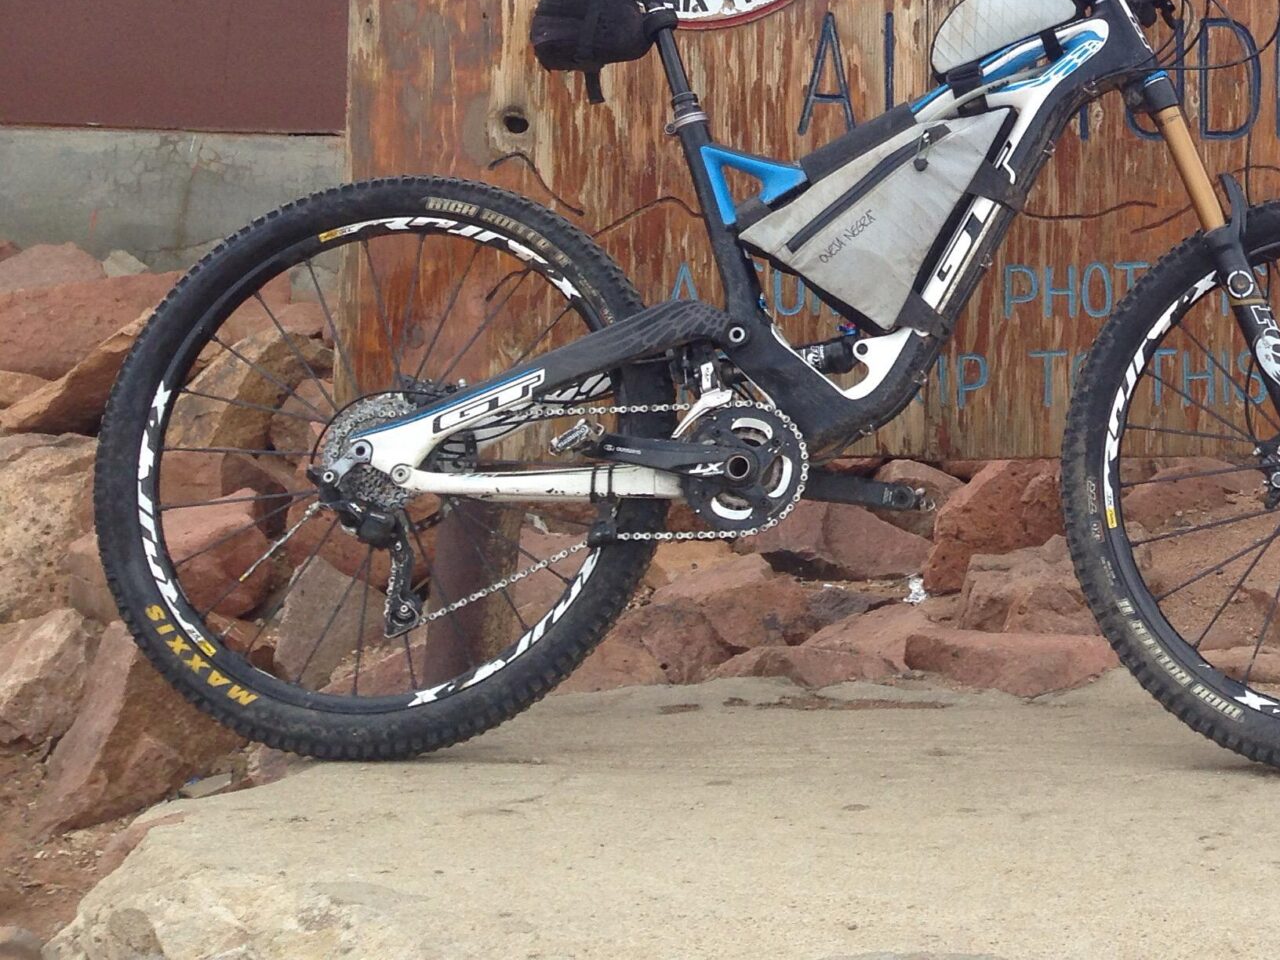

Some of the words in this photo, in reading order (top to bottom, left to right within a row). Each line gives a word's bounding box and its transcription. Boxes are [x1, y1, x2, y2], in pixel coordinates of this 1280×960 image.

[1004, 260, 1150, 319] PHOT
[434, 369, 546, 435] GT
[1153, 349, 1268, 407] THIS
[145, 604, 259, 707] MAXXIS
